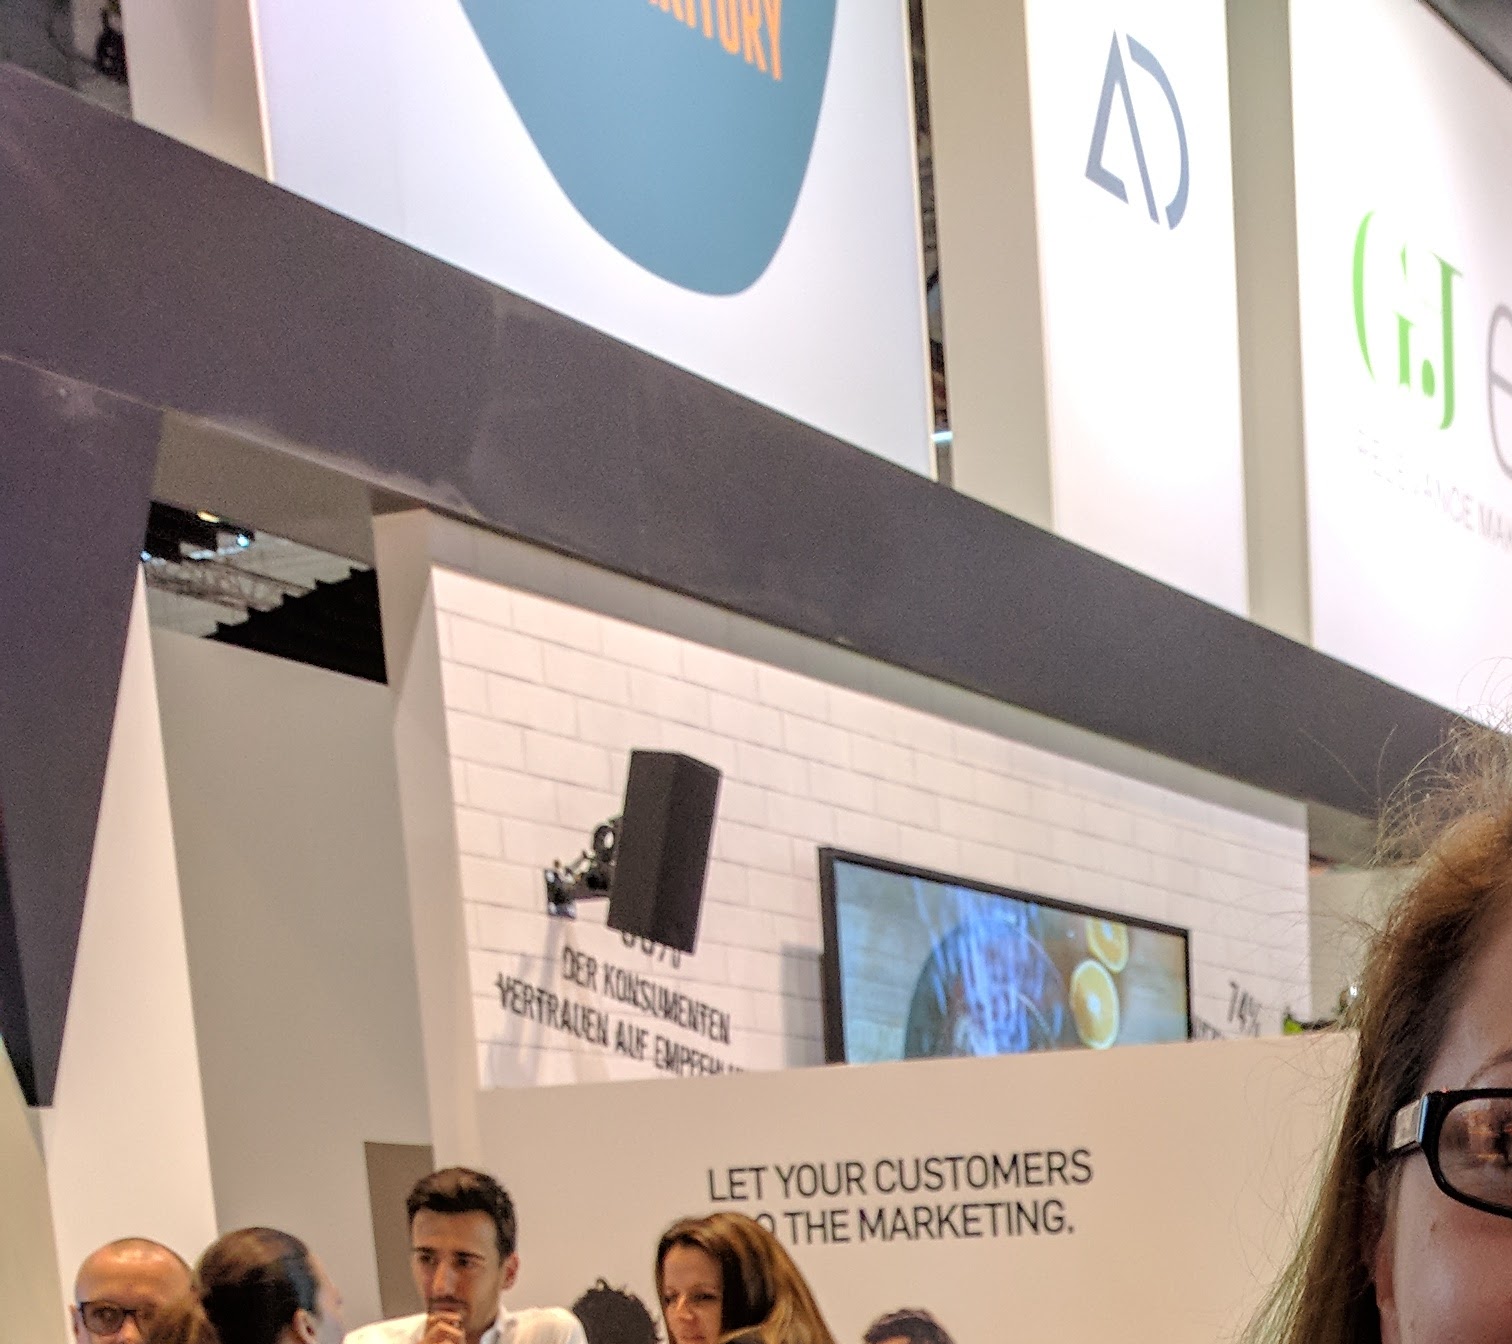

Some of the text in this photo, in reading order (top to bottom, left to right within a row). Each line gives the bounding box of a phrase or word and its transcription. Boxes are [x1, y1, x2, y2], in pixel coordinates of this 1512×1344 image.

[495, 972, 610, 1047] VERTRAUEN
[615, 1020, 649, 1061] AUF
[562, 946, 598, 991] DER
[602, 963, 731, 1045] KONSUMENTEN
[707, 1148, 1094, 1202] LET YOUR CUSTOMERS
[784, 1209, 851, 1246] THE
[858, 1199, 1075, 1244] MARKETING.
